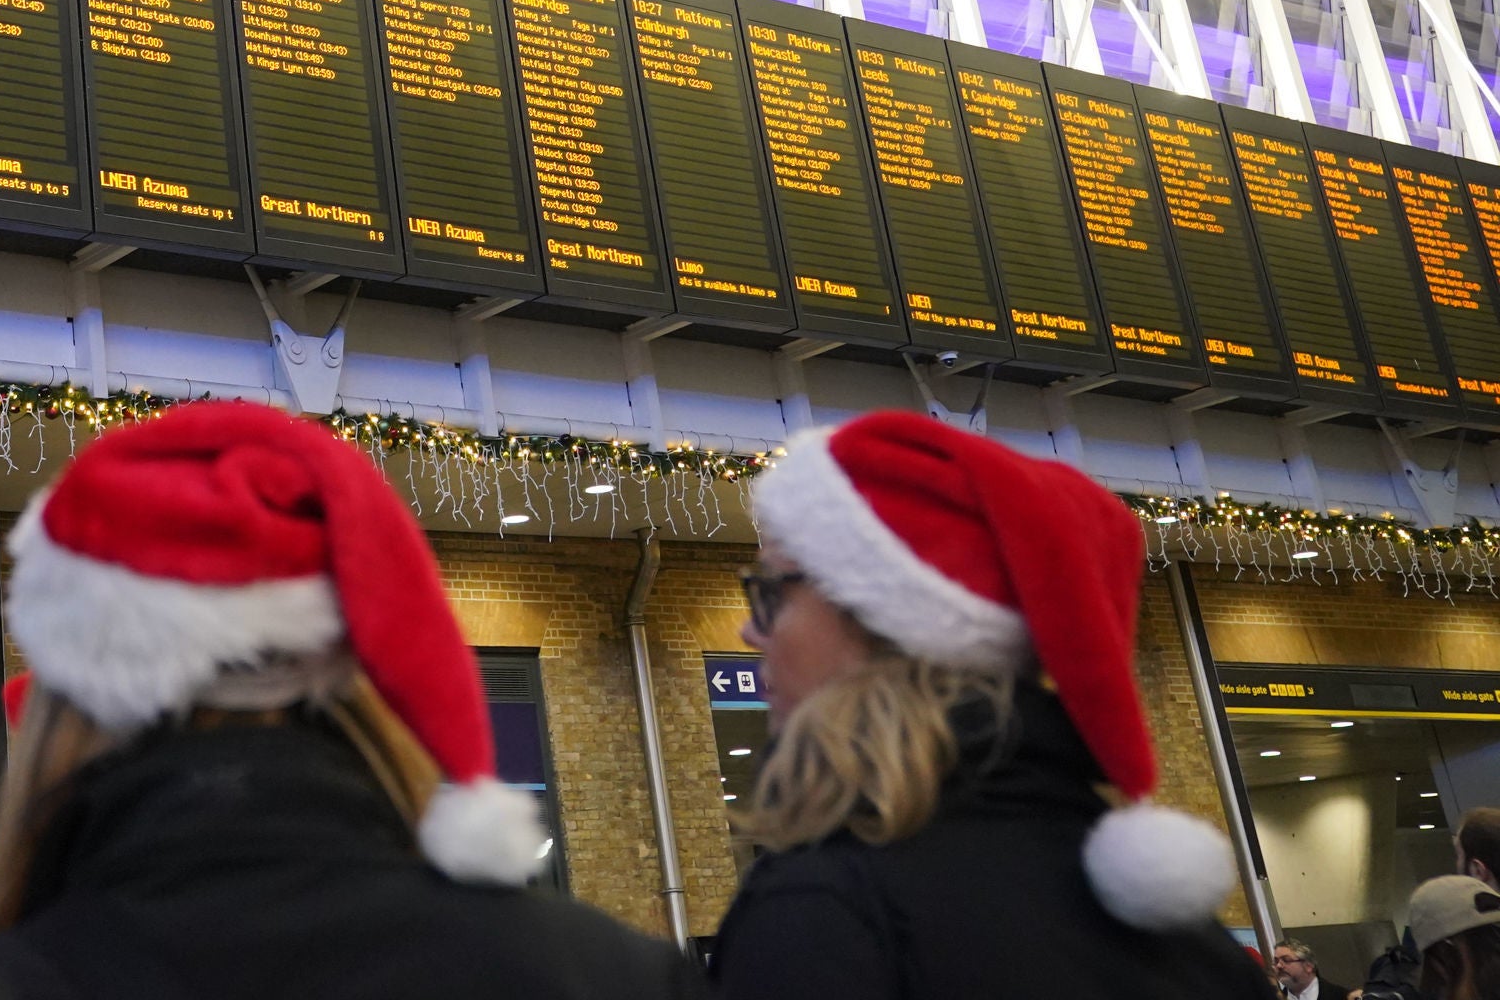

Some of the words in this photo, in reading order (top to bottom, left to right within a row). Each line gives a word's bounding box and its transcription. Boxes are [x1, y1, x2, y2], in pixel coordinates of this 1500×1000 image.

[633, 15, 690, 40] Edinburgh
[673, 7, 722, 30] Platform
[747, 24, 777, 42] 18:30
[787, 32, 831, 54] Platform
[749, 41, 802, 64] Newcastle
[856, 49, 885, 66] 18:33
[893, 56, 936, 77] Platform
[859, 65, 890, 83] Leeds
[958, 71, 985, 88] 18:42
[992, 78, 1033, 98] Platform
[970, 89, 1018, 111] Cambridge
[1054, 92, 1079, 108] 18:57
[1087, 99, 1126, 118] Platform
[1058, 108, 1109, 130] Letchworth
[1176, 119, 1213, 137] Platform
[1148, 128, 1190, 147] Newcastle
[1262, 138, 1297, 156] Platform
[29, 182, 43, 194] up
[46, 183, 59, 194] to
[62, 184, 69, 196] 5
[100, 170, 137, 190] LNER
[142, 177, 189, 198] Azuma
[260, 194, 302, 215] Great
[306, 201, 371, 226] Northern
[408, 217, 441, 236] LNER
[445, 223, 485, 243] Azuma
[547, 238, 583, 257] Great
[586, 244, 643, 266] Northern
[674, 258, 704, 274] Lumo
[794, 276, 821, 292] LNER
[824, 280, 857, 298] Azuma
[906, 293, 932, 309] LNER
[1011, 309, 1039, 325] Great
[1040, 313, 1086, 331] Northern
[1252, 686, 1268, 696] gate
[1442, 690, 1461, 700] Wide
